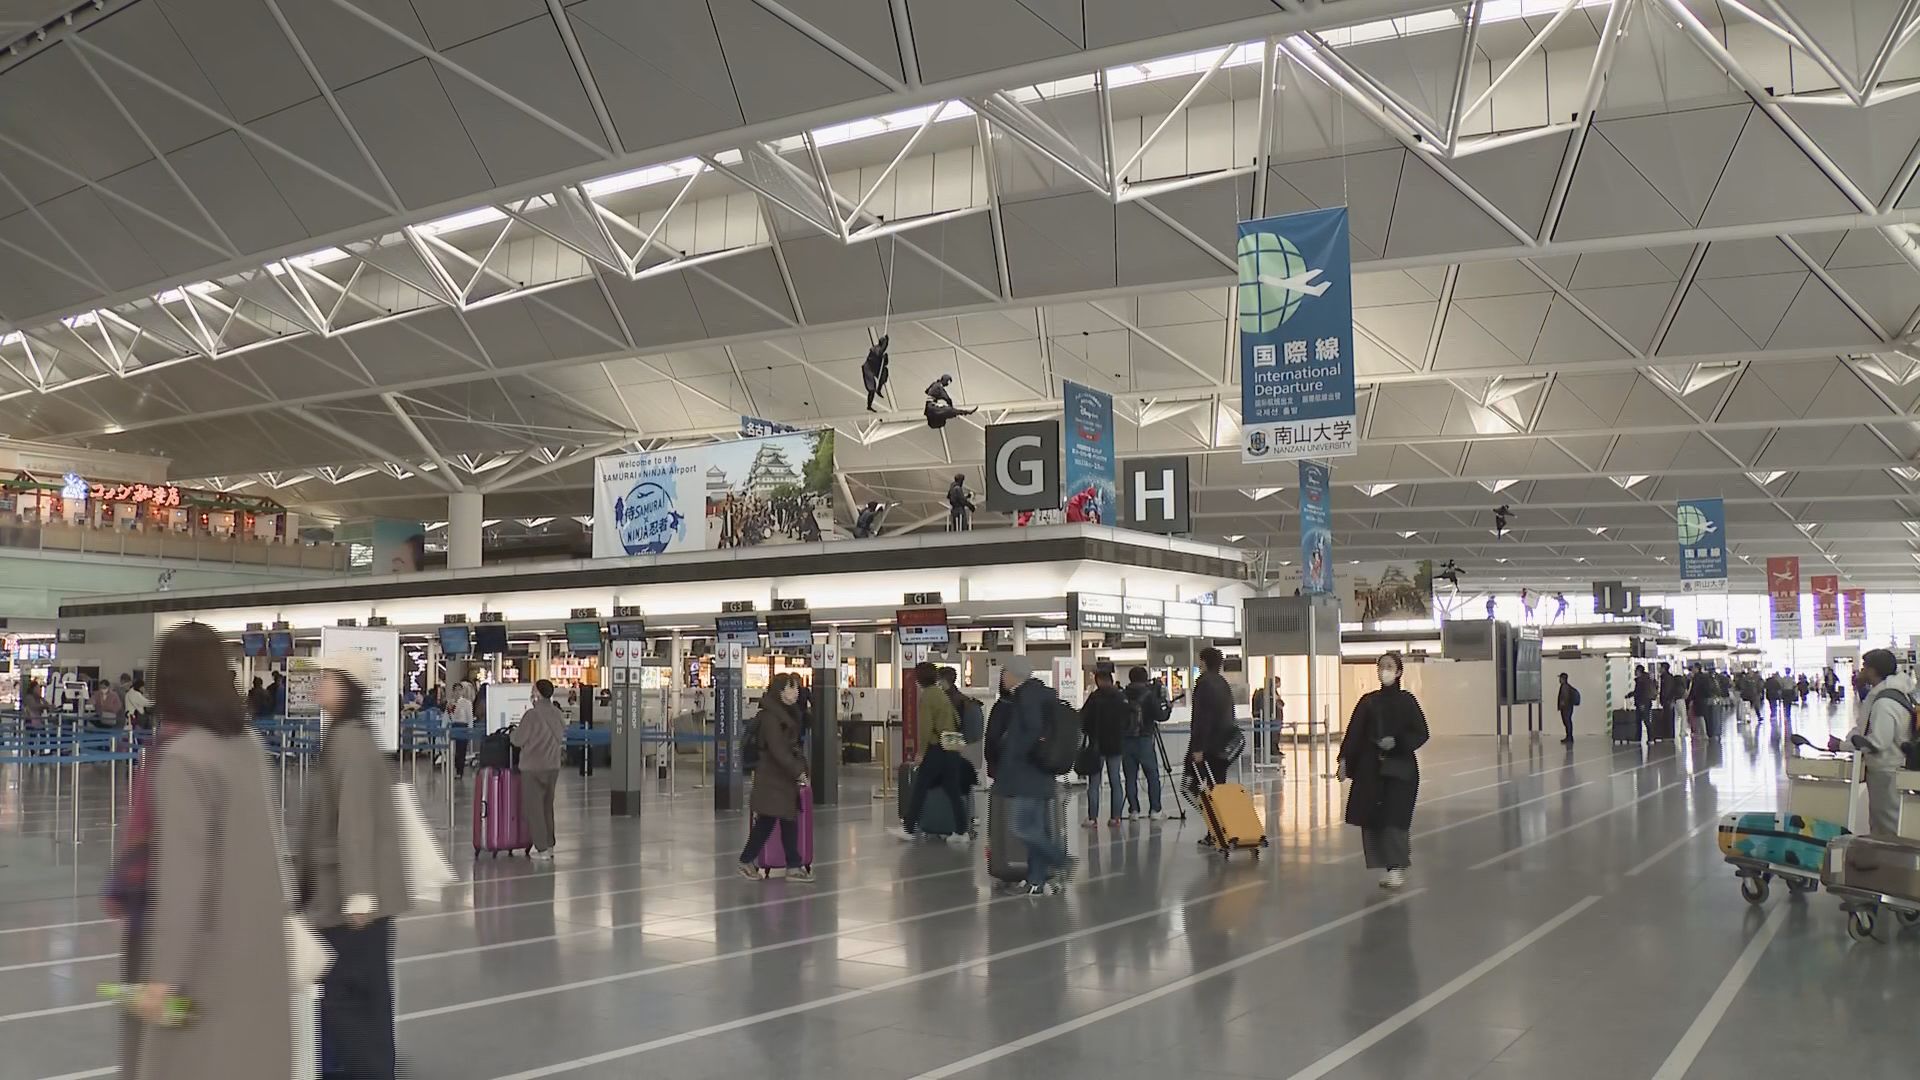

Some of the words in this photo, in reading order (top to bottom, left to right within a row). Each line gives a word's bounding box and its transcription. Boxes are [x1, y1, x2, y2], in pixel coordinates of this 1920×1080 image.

[1253, 336, 1340, 368] 国際線
[1254, 362, 1341, 383] International
[1255, 381, 1324, 398] Departure
[1274, 420, 1352, 446] 南山大学
[1273, 444, 1307, 455] NANZAN
[1307, 441, 1352, 452] UNIVERSITY
[618, 458, 651, 469] Welcome
[654, 457, 663, 465] to
[664, 455, 678, 464] the
[995, 435, 1044, 496] G
[669, 464, 697, 476] Airport
[1134, 469, 1175, 522] H
[781, 599, 795, 610] G2
[913, 593, 928, 604] G1
[1604, 586, 1611, 609] I
[1621, 591, 1633, 613] J
[577, 609, 588, 618] G5
[620, 607, 631, 616] G4
[730, 602, 743, 612] G3
[1645, 608, 1658, 623] K
